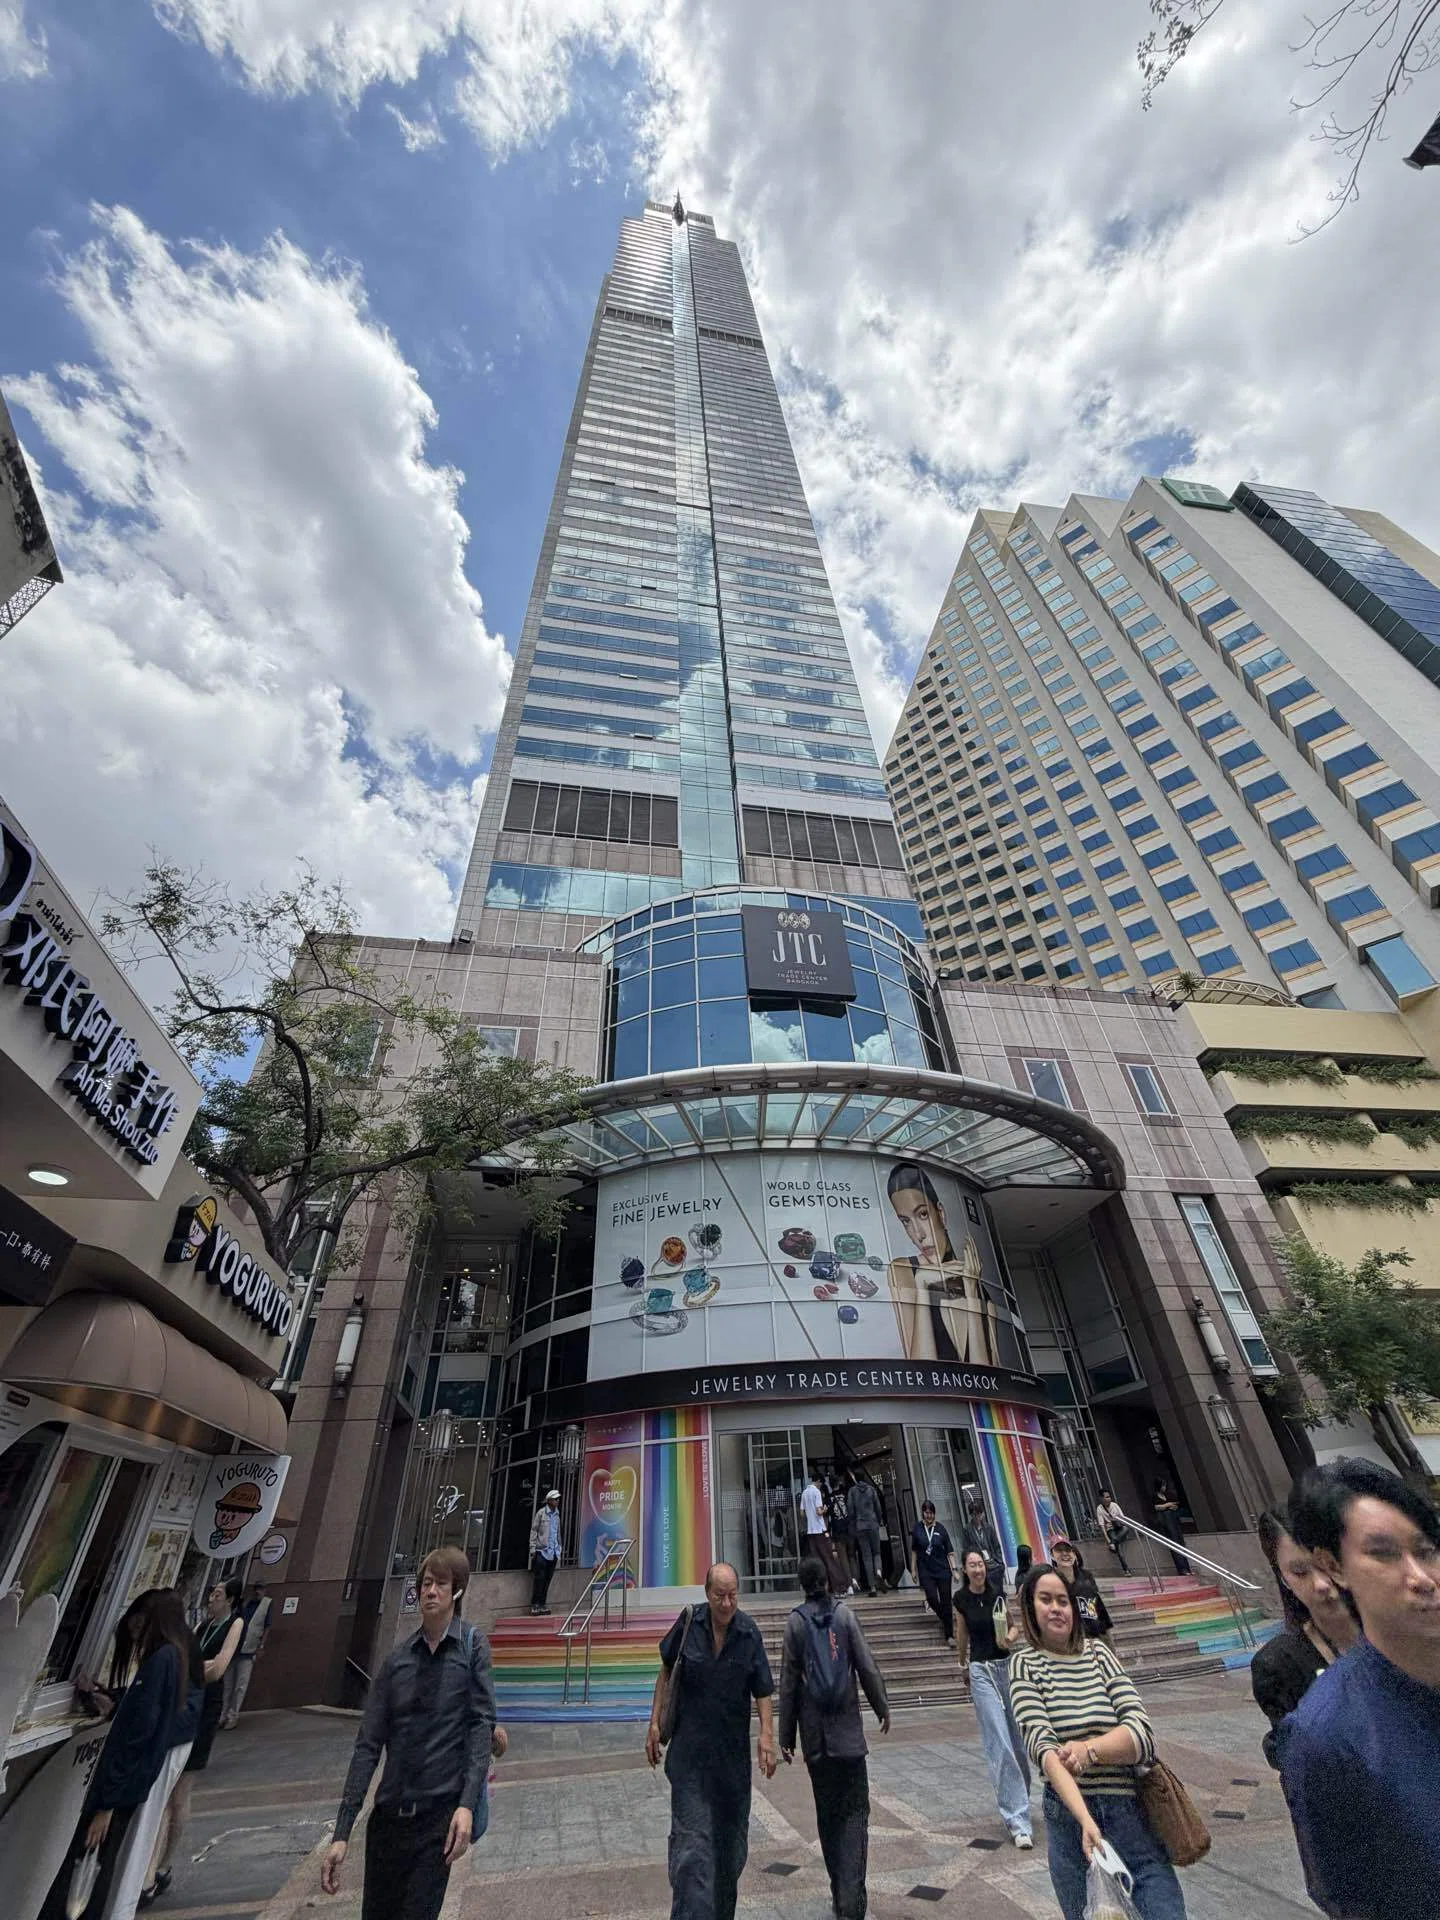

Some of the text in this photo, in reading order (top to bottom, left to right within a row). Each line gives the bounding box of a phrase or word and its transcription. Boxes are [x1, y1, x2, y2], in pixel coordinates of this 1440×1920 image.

[772, 930, 827, 966] JTC
[73, 1063, 160, 1165] Ah Ma Shou Zuo
[767, 1181, 851, 1191] WORLD CLASS
[612, 1192, 669, 1212] EXCLUSIVE
[612, 1197, 722, 1228] FINE JEWELRY
[769, 1195, 870, 1210] GEMSTONES
[208, 1223, 294, 1336] YOGURUTO
[690, 1374, 777, 1396] JEWELRY
[786, 1371, 849, 1389] TRADE
[857, 1371, 925, 1387] CENTER
[932, 1372, 1000, 1391] BANGKOK
[216, 1462, 279, 1489] YOGURUTO
[600, 1491, 625, 1502] PRIDE
[663, 1505, 671, 1530] LOVE
[663, 1543, 671, 1568] LOVE
